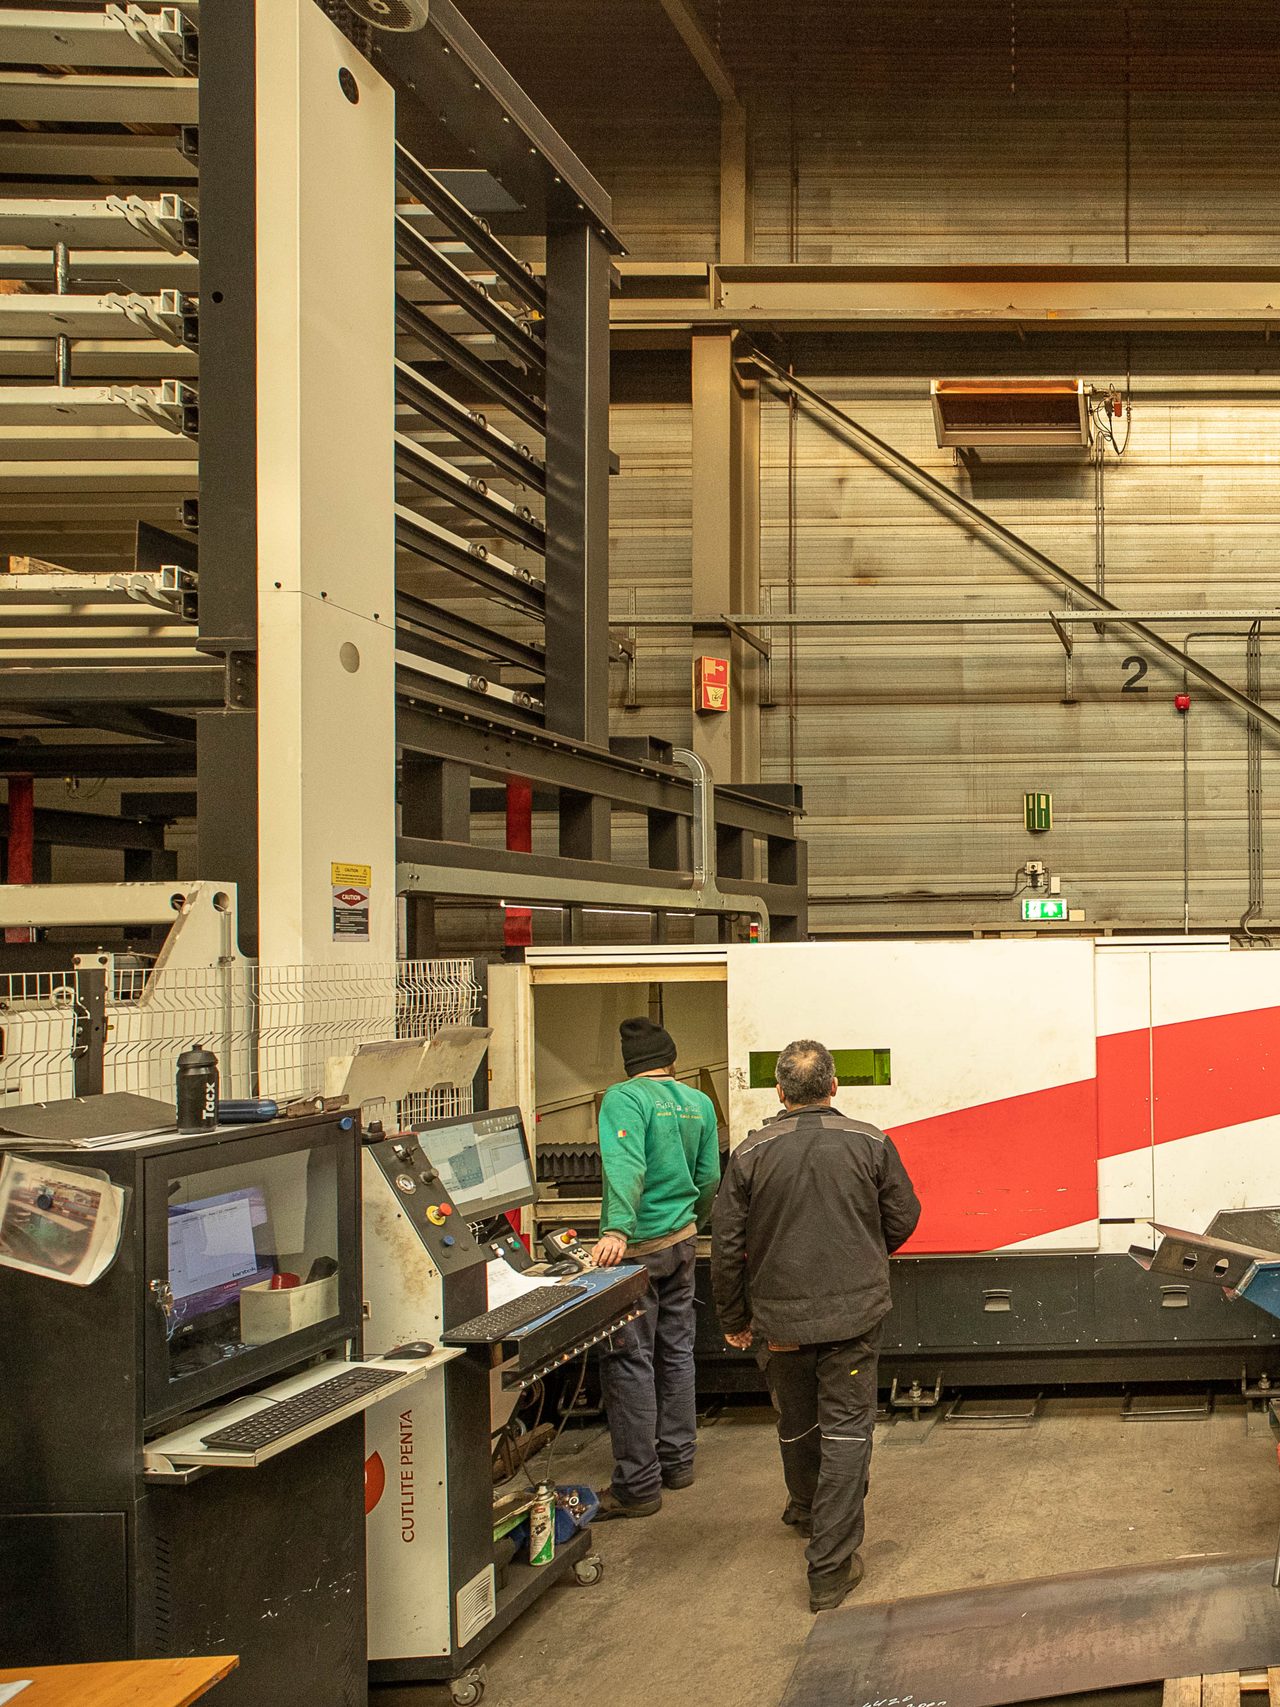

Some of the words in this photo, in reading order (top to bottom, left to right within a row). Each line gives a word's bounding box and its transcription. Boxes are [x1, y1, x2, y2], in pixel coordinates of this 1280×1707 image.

[1121, 655, 1148, 692] 2
[202, 1082, 215, 1120] Tacx
[400, 1409, 414, 1465] PENTA
[401, 1470, 415, 1543] CUTLITE
